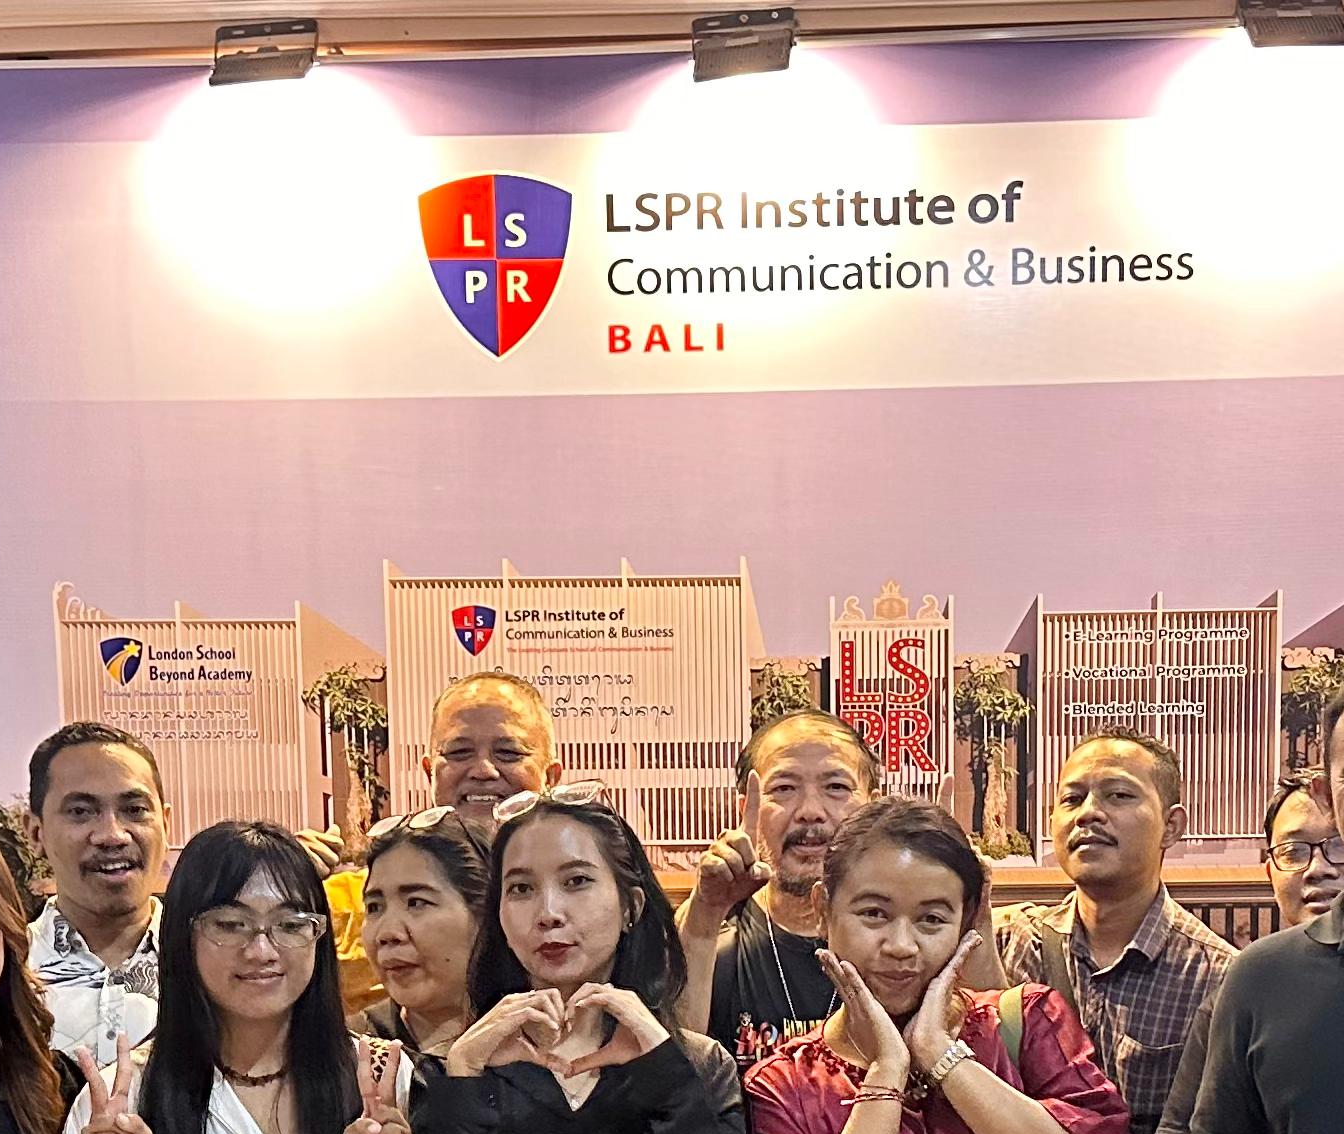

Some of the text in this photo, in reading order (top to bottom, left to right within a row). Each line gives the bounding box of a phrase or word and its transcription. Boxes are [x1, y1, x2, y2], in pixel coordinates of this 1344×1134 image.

[605, 180, 1024, 233] LSPR Institute of
[607, 245, 1194, 296] Communication & Business
[608, 322, 725, 354] BALI
[505, 607, 626, 623] LSPR Institute of
[505, 625, 674, 641] Communication & Business
[1073, 628, 1248, 643] E-Learning Programme
[148, 644, 236, 660] London School
[149, 665, 252, 684] Beyond Academy
[1072, 665, 1246, 680] Vocational Programme
[1072, 701, 1205, 716] Blended Learning
